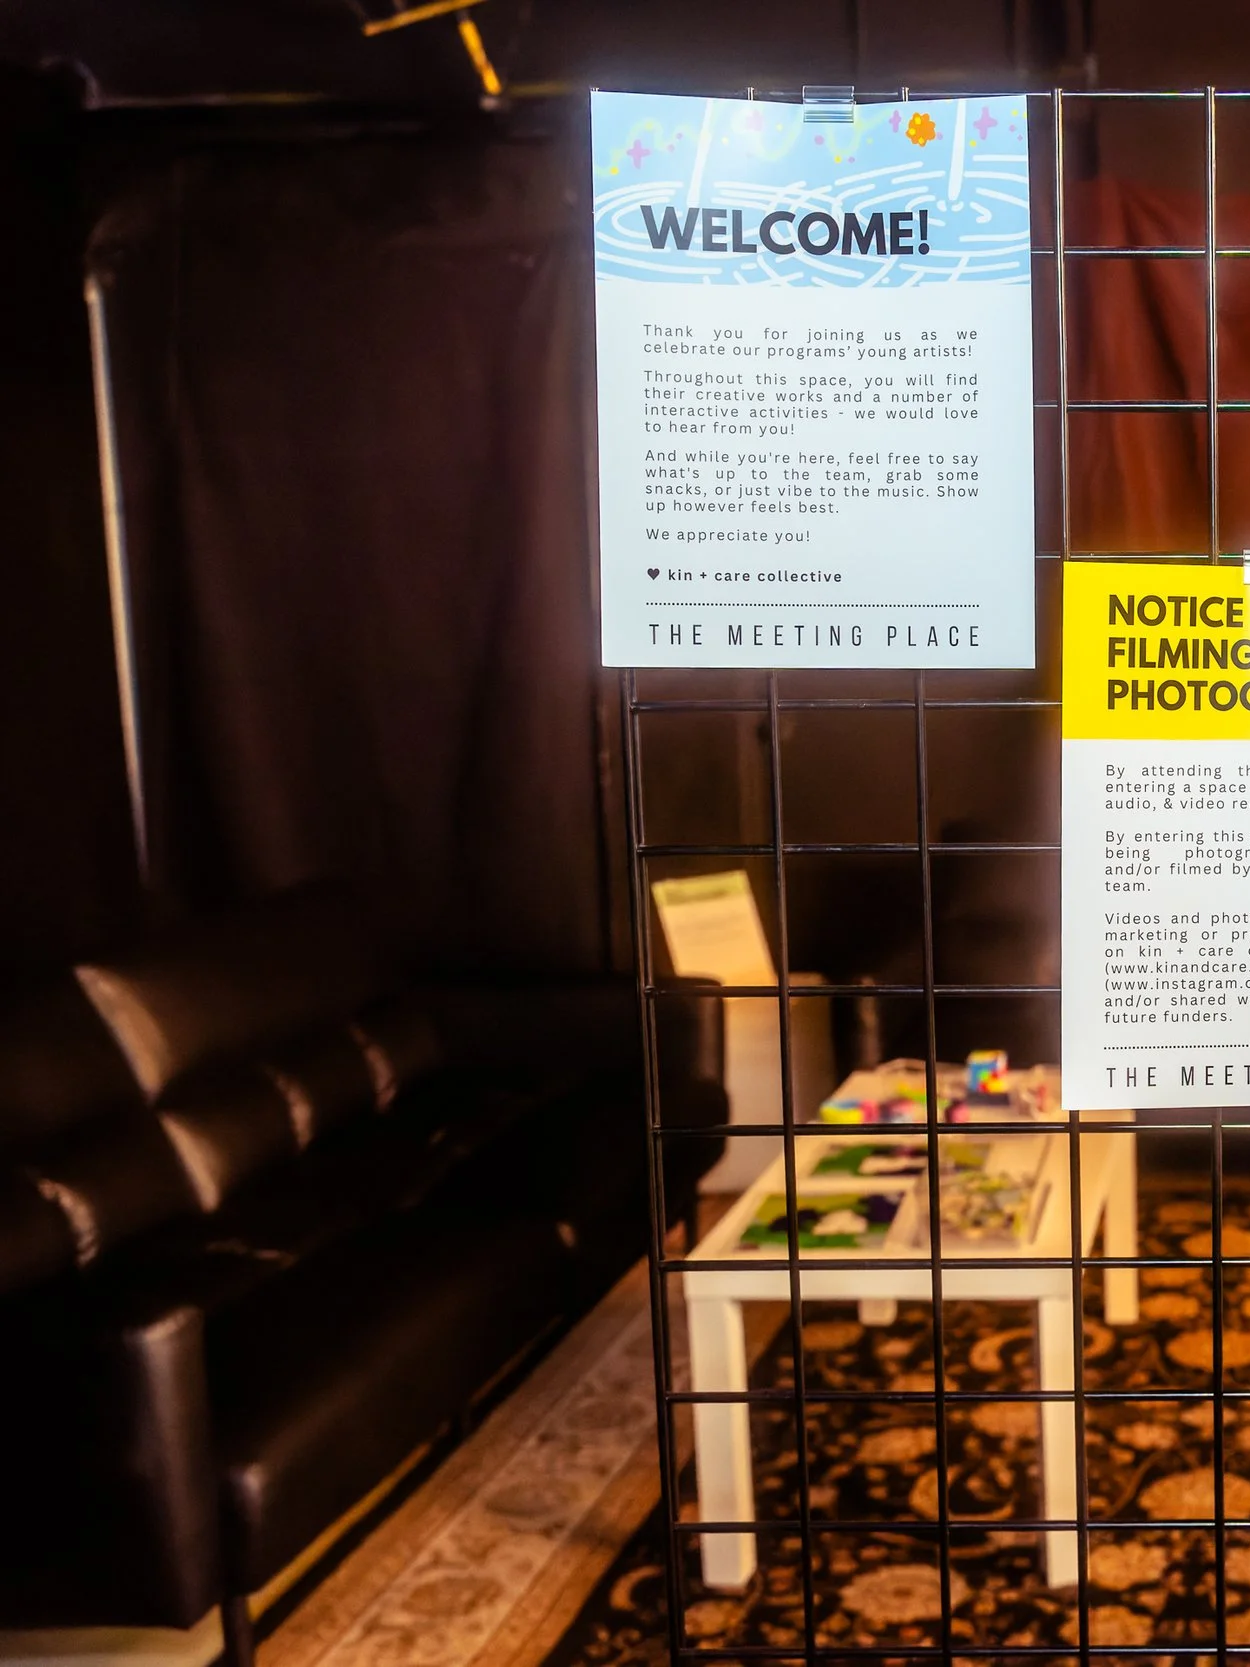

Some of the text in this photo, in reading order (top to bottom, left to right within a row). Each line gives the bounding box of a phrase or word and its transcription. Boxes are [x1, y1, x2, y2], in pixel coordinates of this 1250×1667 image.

[640, 204, 931, 255] WELCOME!
[643, 324, 977, 344] Thank you for joining us as we
[643, 341, 725, 355] celebrate
[733, 346, 760, 356] our
[857, 347, 907, 361] young
[913, 345, 971, 358] artists!
[643, 370, 977, 390] Throughout this space, you will find
[644, 386, 979, 403] their creative works and a number of
[644, 420, 794, 438] to hear from you!
[645, 449, 978, 468] And while you're here, feel free to say
[646, 499, 839, 514] up however feels best.
[646, 528, 810, 545] We appreciate you!
[668, 568, 692, 581] kin
[714, 572, 751, 582] care
[757, 570, 842, 583] collective
[1108, 594, 1244, 628] NOTICE
[648, 624, 979, 647] THE MEETING PLACE
[1106, 764, 1125, 780] By
[1141, 764, 1222, 780] attending
[1105, 780, 1176, 796] entering
[1183, 783, 1192, 793] a
[1199, 783, 1246, 796] space
[1105, 797, 1156, 812] audio,
[1163, 797, 1173, 810] &
[1179, 797, 1225, 810] video
[1105, 846, 1151, 862] being
[1105, 862, 1161, 877] and/or
[1169, 862, 1222, 875] filmed
[1232, 862, 1250, 878] by
[1105, 912, 1161, 925] Videos
[1171, 912, 1200, 925] and
[1105, 928, 1188, 944] marketing
[1201, 930, 1218, 941] or
[1104, 994, 1160, 1008] and/or
[1170, 993, 1226, 1007] shared
[1104, 1010, 1232, 1024] future funders.
[1106, 1066, 1157, 1088] THE
